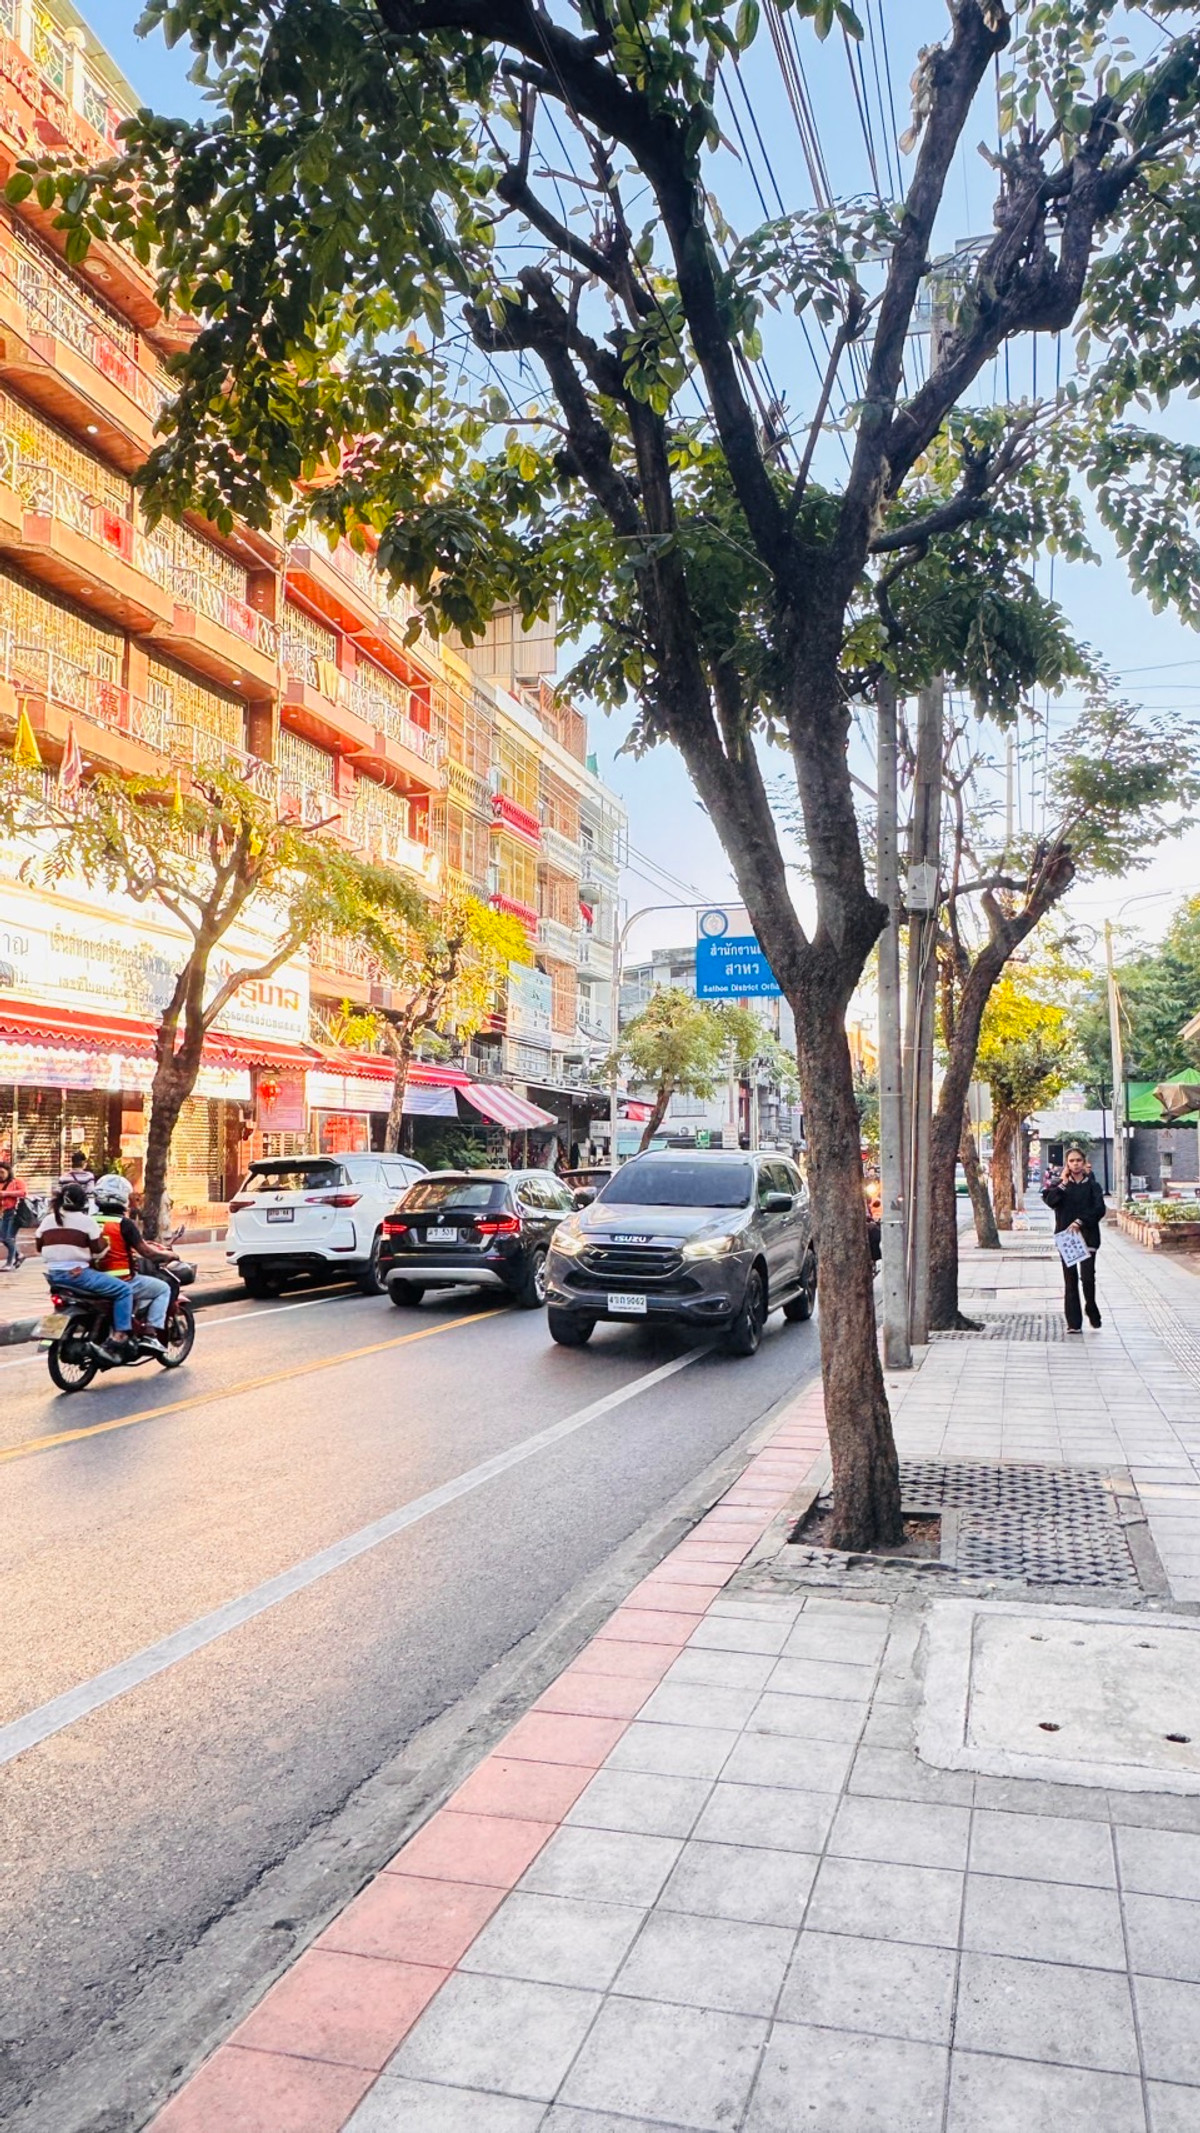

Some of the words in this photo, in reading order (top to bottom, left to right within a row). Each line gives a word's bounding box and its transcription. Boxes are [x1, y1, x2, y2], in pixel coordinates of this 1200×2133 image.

[710, 942, 763, 956] สำนักงานเ
[725, 962, 760, 976] สาทร
[731, 983, 759, 992] District
[761, 982, 780, 991] Offic
[614, 1235, 647, 1243] ISUZU
